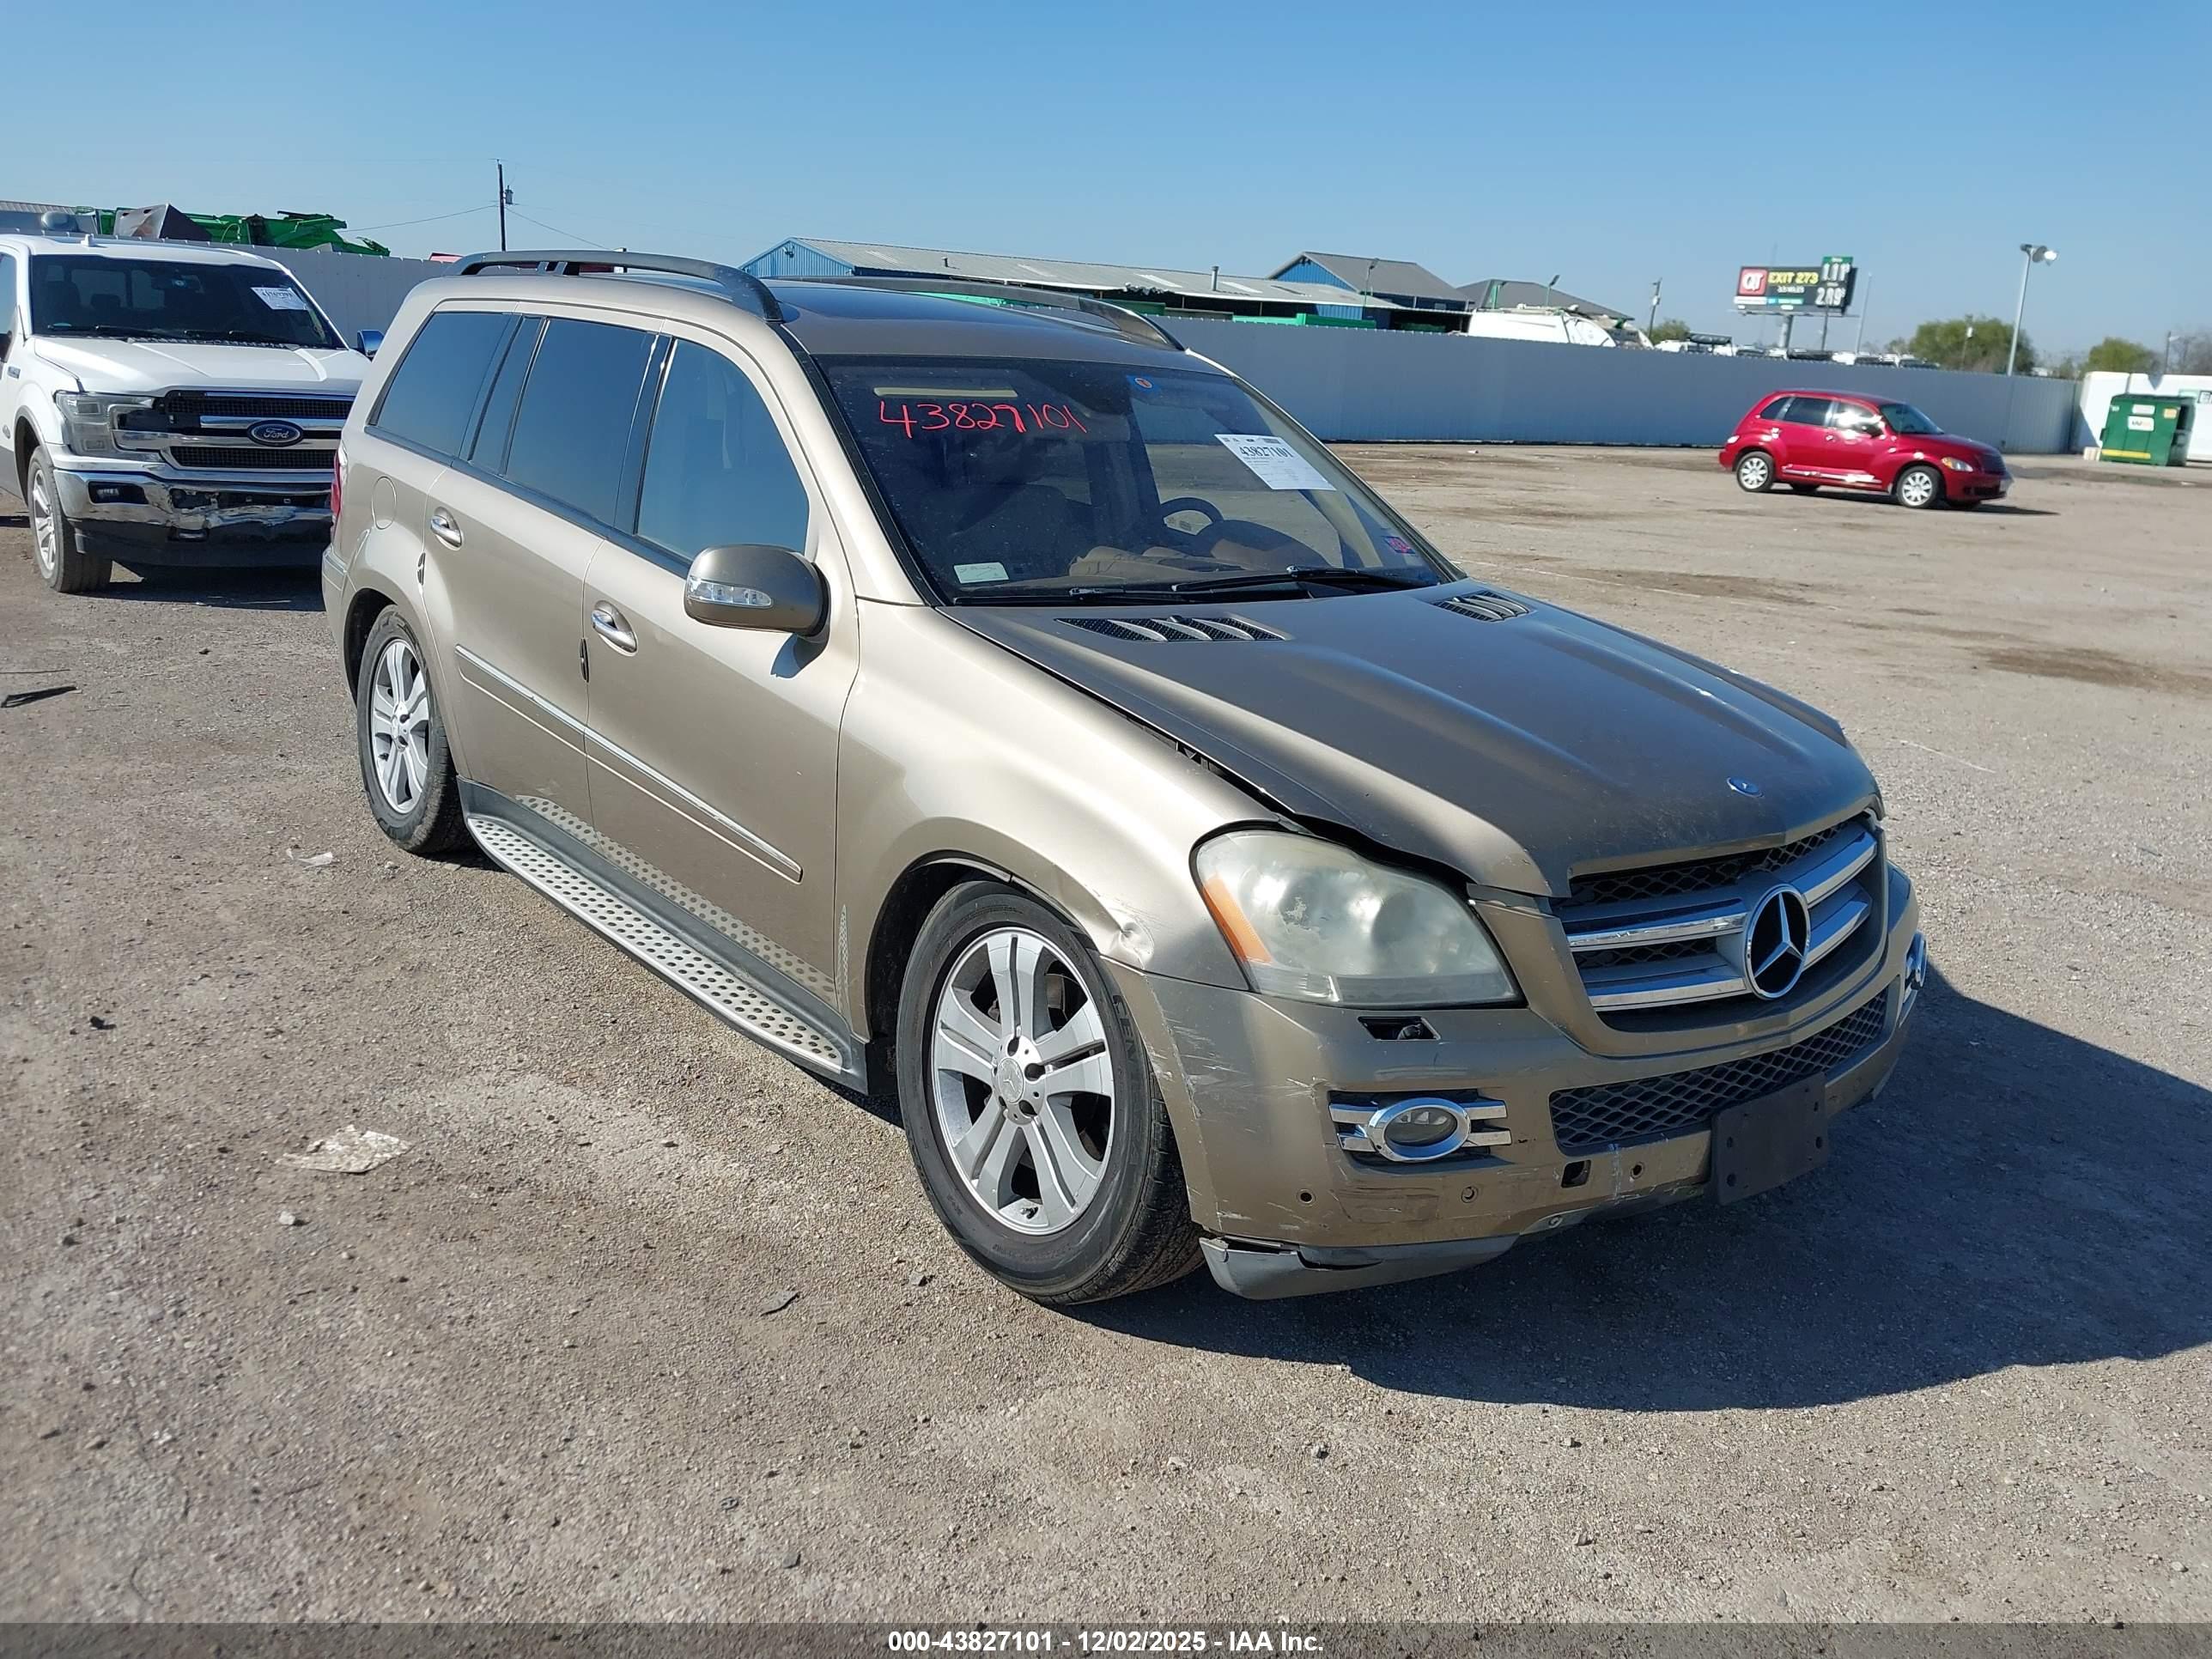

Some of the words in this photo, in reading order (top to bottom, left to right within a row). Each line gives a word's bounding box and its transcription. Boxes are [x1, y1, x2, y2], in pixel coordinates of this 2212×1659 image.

[1742, 273, 1764, 292] QT
[1768, 271, 1795, 284] EXIT
[1795, 271, 1819, 284] 273
[879, 400, 1087, 439] 43827101
[263, 427, 289, 439] Ford
[1239, 446, 1294, 459] 43827101
